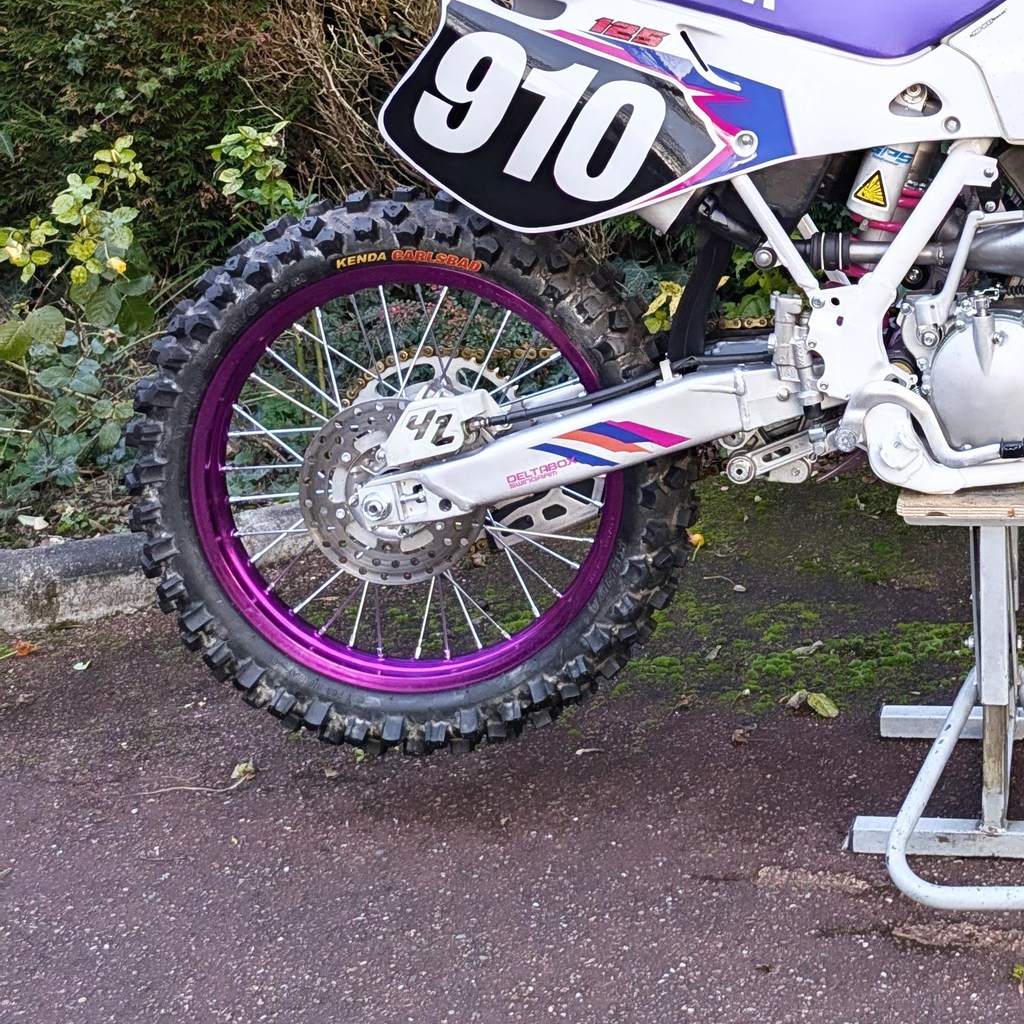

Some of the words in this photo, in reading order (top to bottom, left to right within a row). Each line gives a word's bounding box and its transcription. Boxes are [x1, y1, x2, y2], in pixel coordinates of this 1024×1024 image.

[589, 16, 670, 48] 125
[413, 31, 667, 202] 910
[336, 251, 387, 269] KENDA
[391, 249, 482, 272] CARLSBAD
[406, 409, 455, 447] 42
[506, 456, 577, 484] DELTABOX
